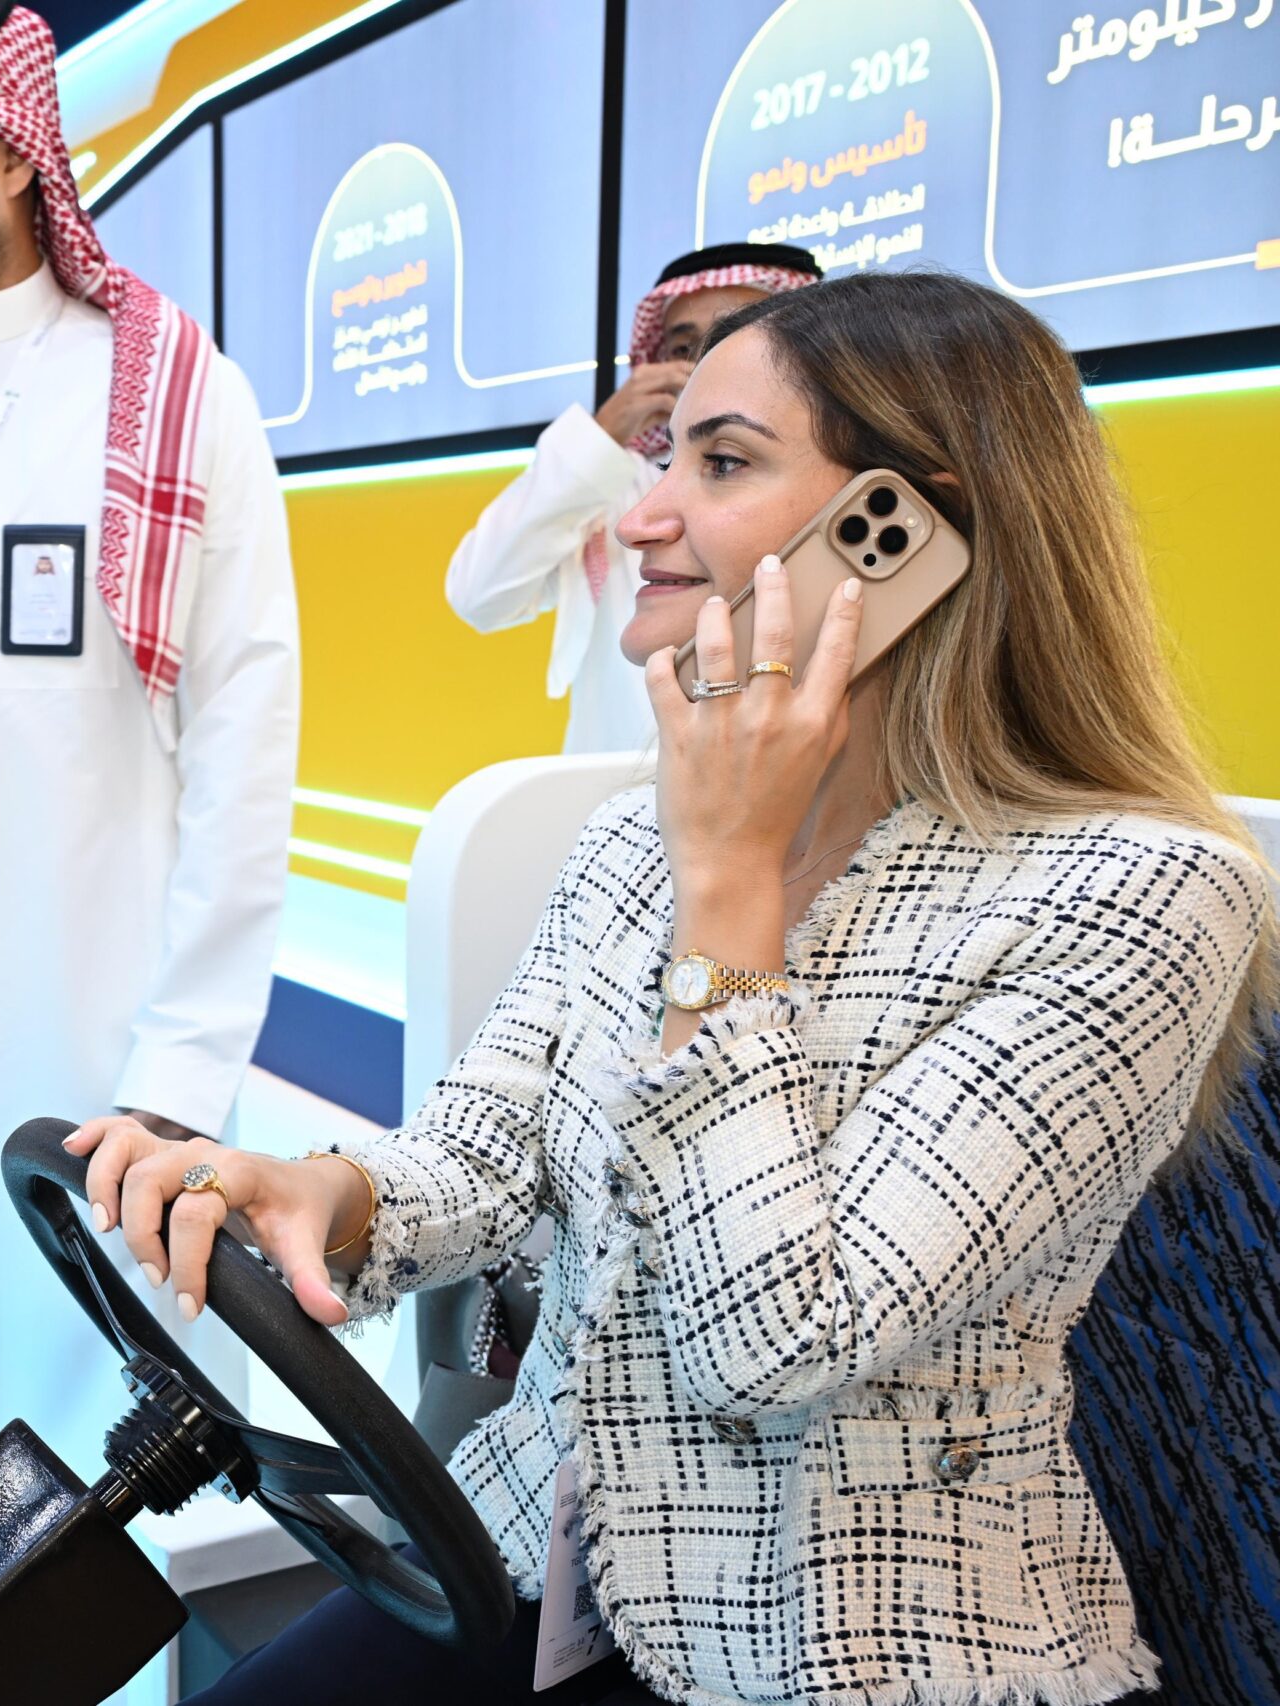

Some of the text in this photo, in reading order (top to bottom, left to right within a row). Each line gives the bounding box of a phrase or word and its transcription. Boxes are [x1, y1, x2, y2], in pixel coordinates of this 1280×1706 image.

[751, 70, 826, 131] 2017
[847, 38, 930, 101] 2012
[1107, 95, 1280, 167] رحلة!
